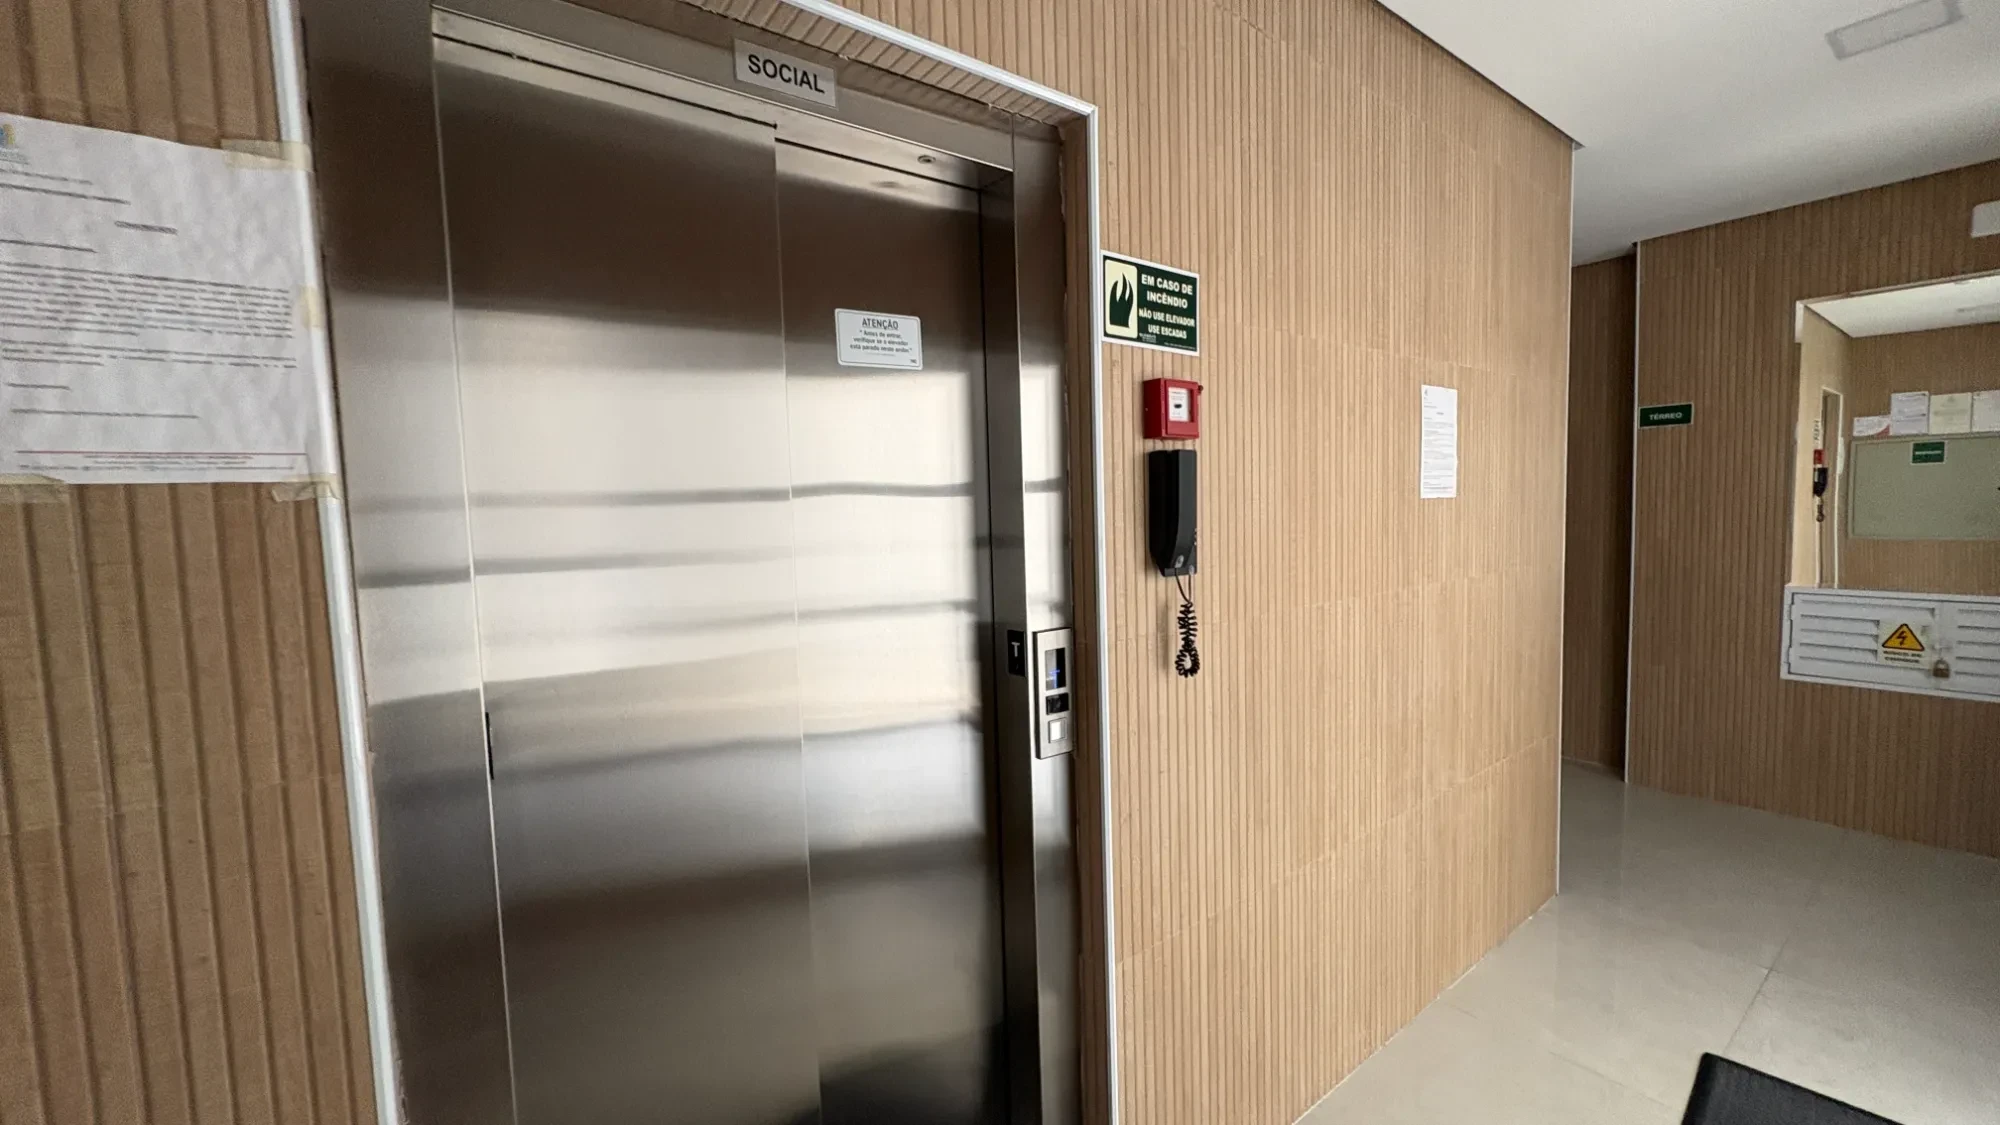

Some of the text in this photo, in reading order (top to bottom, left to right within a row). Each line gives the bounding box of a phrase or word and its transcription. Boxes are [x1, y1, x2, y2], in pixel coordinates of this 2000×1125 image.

[748, 54, 825, 94] SOCIAL
[1141, 274, 1193, 295] EM CASO DE
[1146, 291, 1188, 309] INCÊNDIO
[862, 318, 899, 330] ATENÇÃO
[1138, 307, 1195, 328] NÃO USE ELEVADOR
[1148, 324, 1160, 335] USE
[1161, 326, 1187, 339] ESCADAS
[1649, 412, 1683, 420] TÉRREO
[1011, 641, 1020, 657] T
